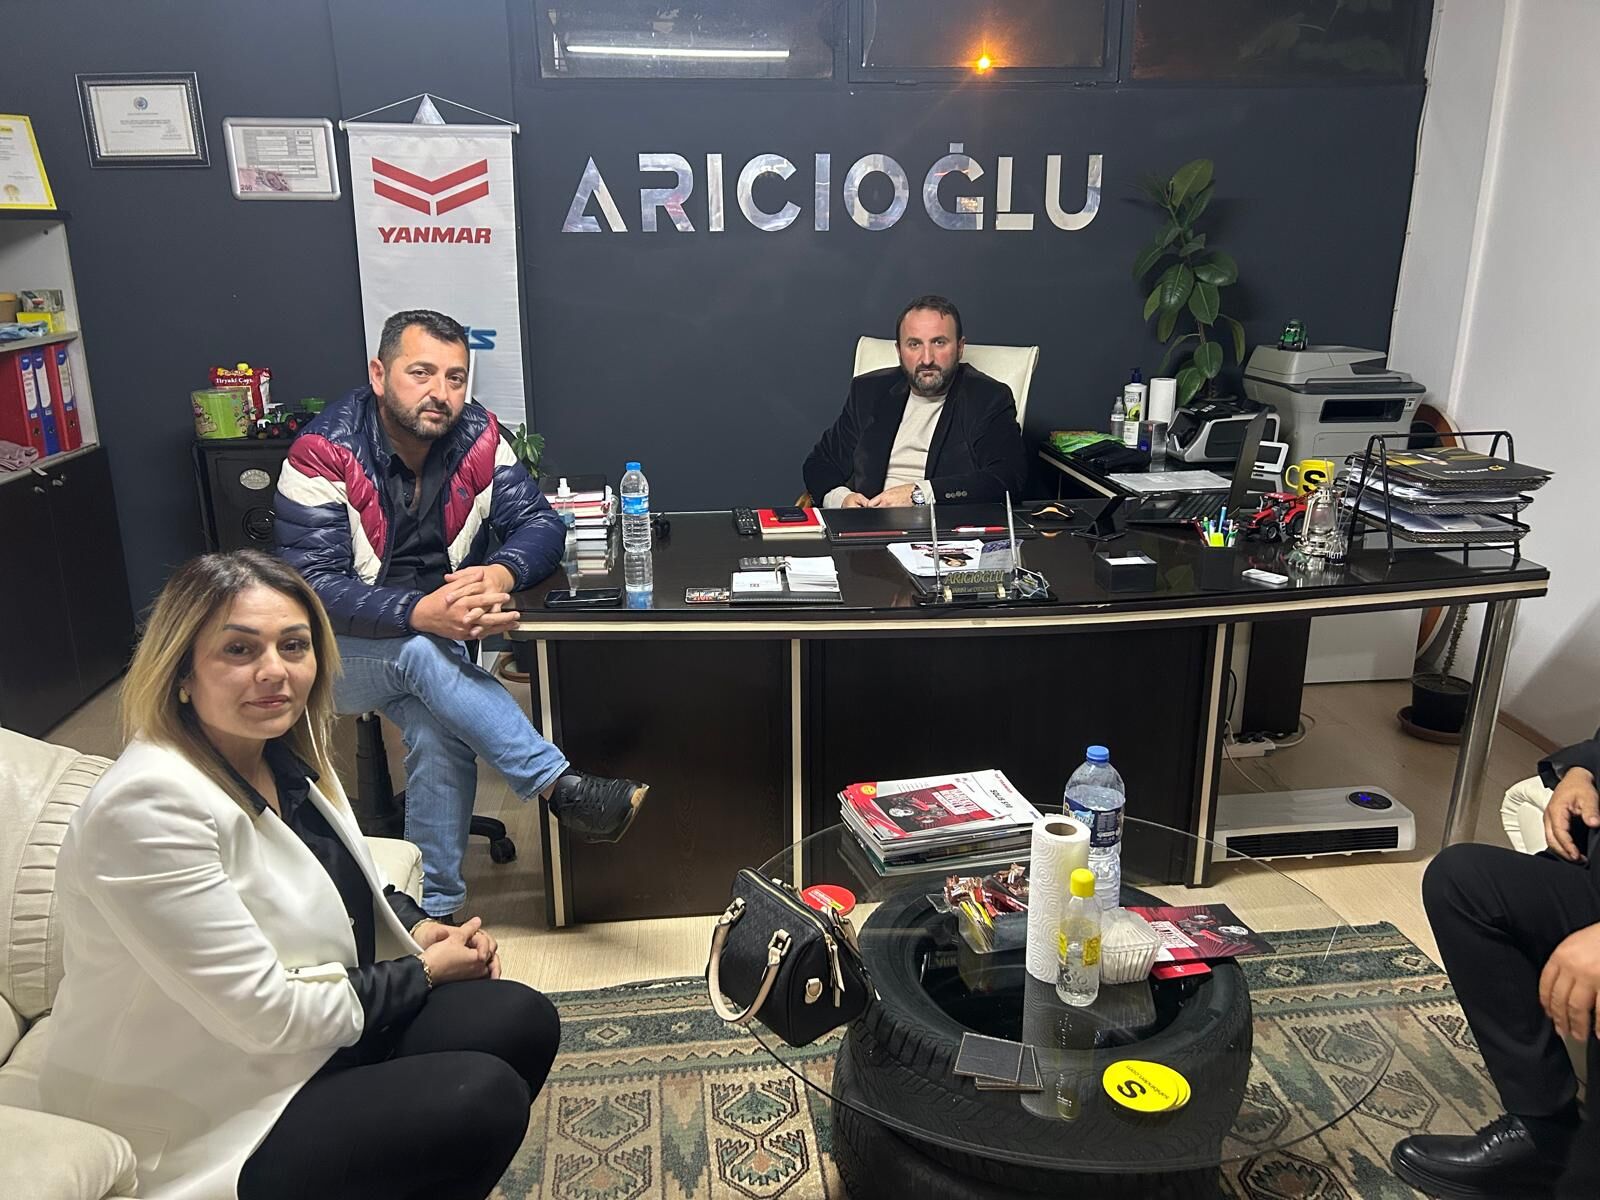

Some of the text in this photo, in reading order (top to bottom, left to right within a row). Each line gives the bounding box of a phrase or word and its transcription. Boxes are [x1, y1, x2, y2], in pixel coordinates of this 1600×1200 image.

[378, 226, 492, 244] YANMAR
[1302, 470, 1326, 493] S
[1117, 1079, 1146, 1099] S
